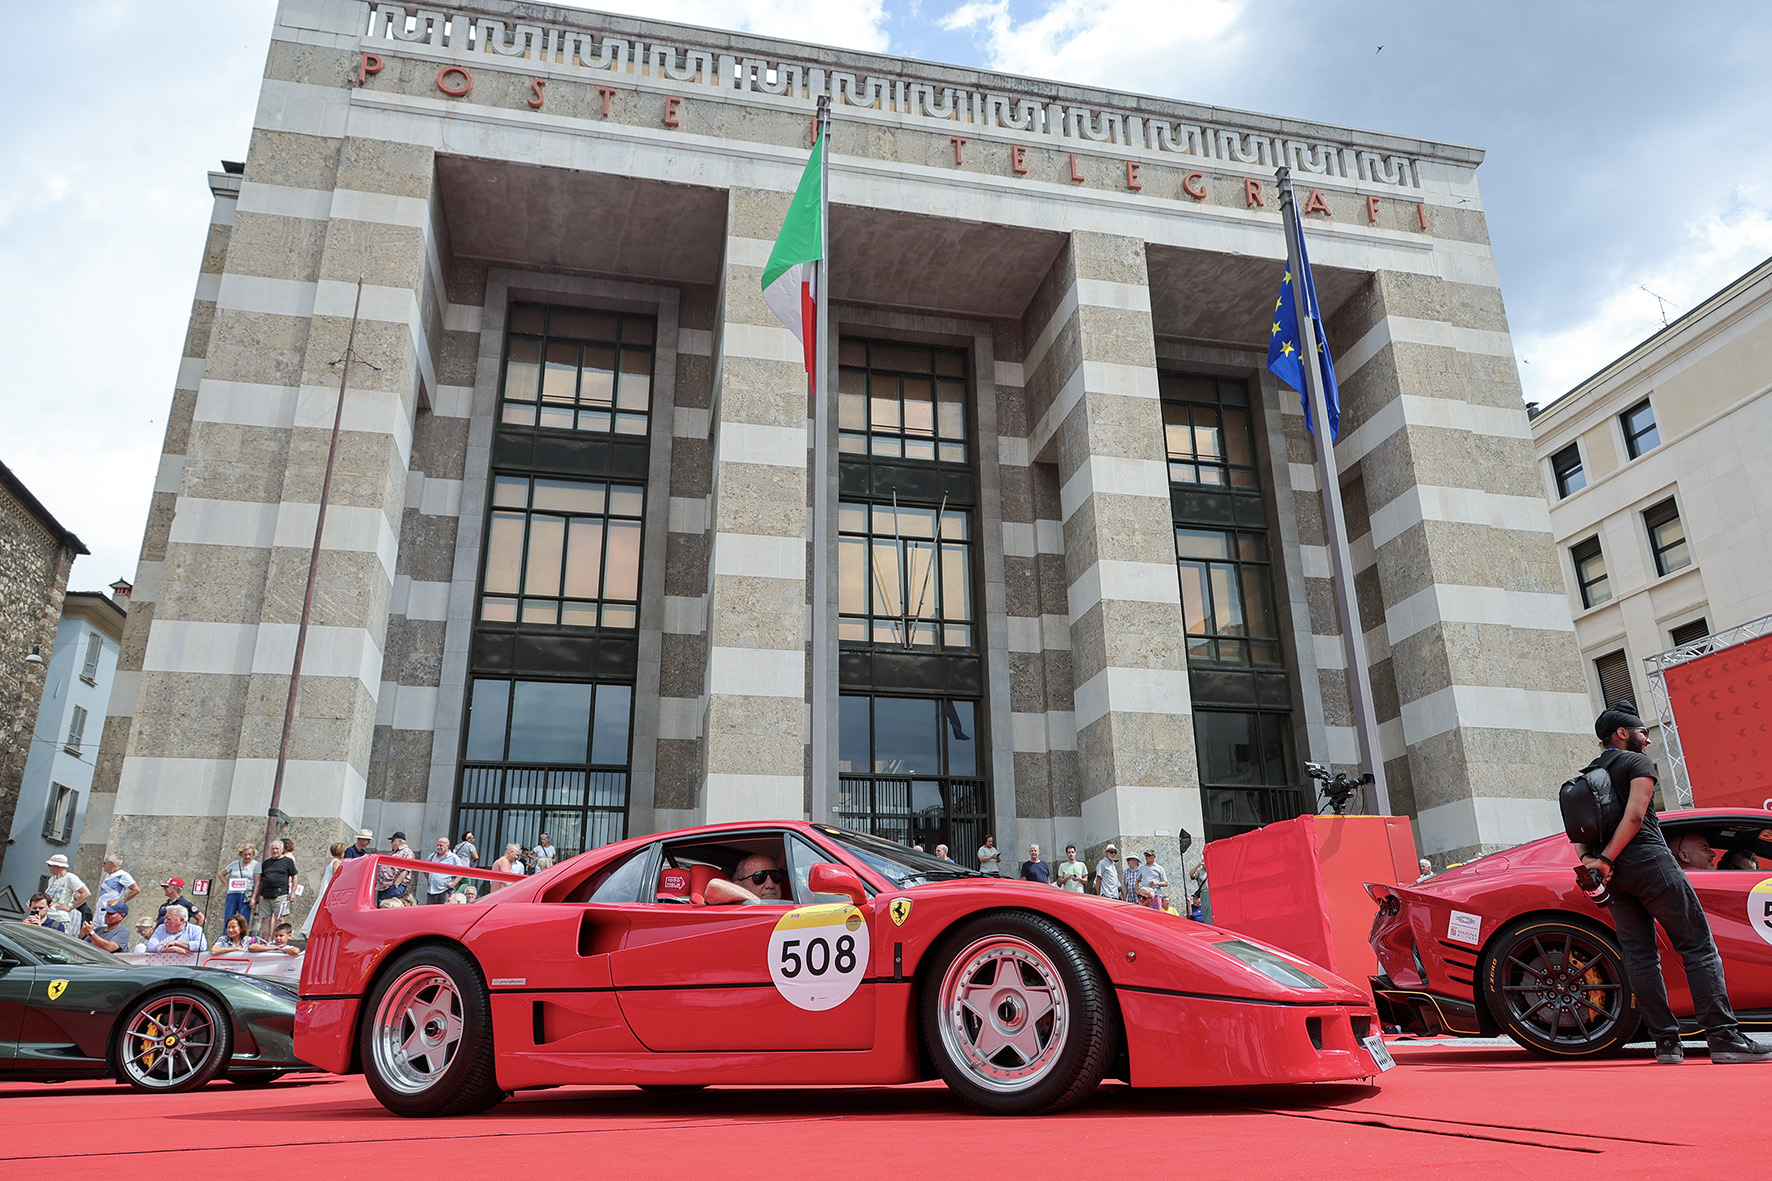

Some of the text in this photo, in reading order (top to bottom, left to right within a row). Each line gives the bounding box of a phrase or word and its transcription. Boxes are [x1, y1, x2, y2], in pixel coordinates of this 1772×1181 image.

[359, 53, 1427, 231] POSTE TELEGRAFI
[780, 935, 857, 978] 508
